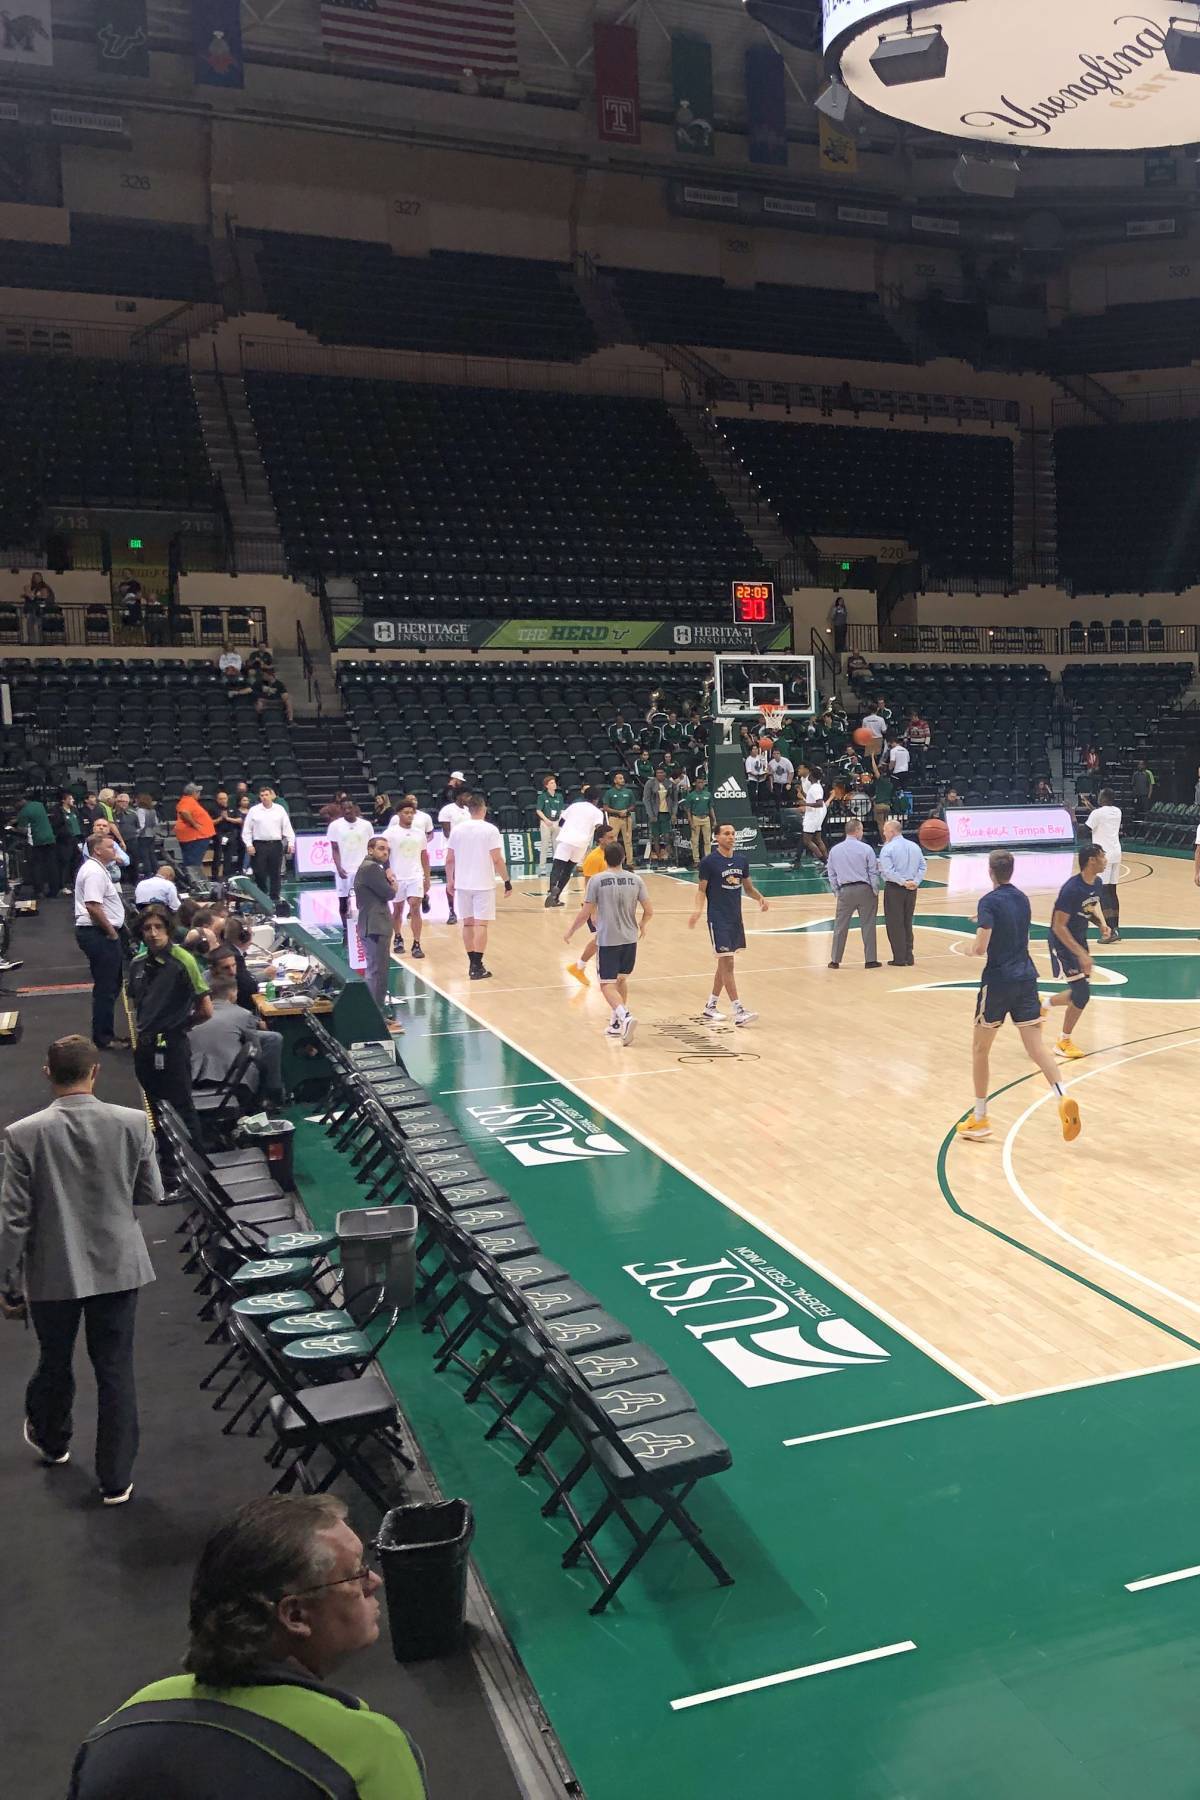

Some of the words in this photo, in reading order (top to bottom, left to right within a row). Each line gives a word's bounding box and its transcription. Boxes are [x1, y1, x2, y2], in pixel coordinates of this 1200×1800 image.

[1109, 68, 1180, 109] CENT
[393, 199, 421, 216] 327
[880, 546, 904, 559] 220
[736, 586, 769, 599] 22:03
[741, 599, 765, 620] 30
[397, 623, 470, 634] HERITAGE
[519, 629, 548, 641] THE
[550, 626, 609, 641] HERD
[398, 633, 470, 642] INSURANCE
[713, 789, 747, 799] adidas
[1013, 825, 1046, 837] Tampa
[1047, 824, 1065, 836] Bay
[466, 1103, 573, 1145] USF
[733, 1246, 768, 1268] UNION
[760, 1264, 797, 1289] CREDIT
[621, 1256, 790, 1340] USF
[791, 1285, 837, 1318] FEDERAL
